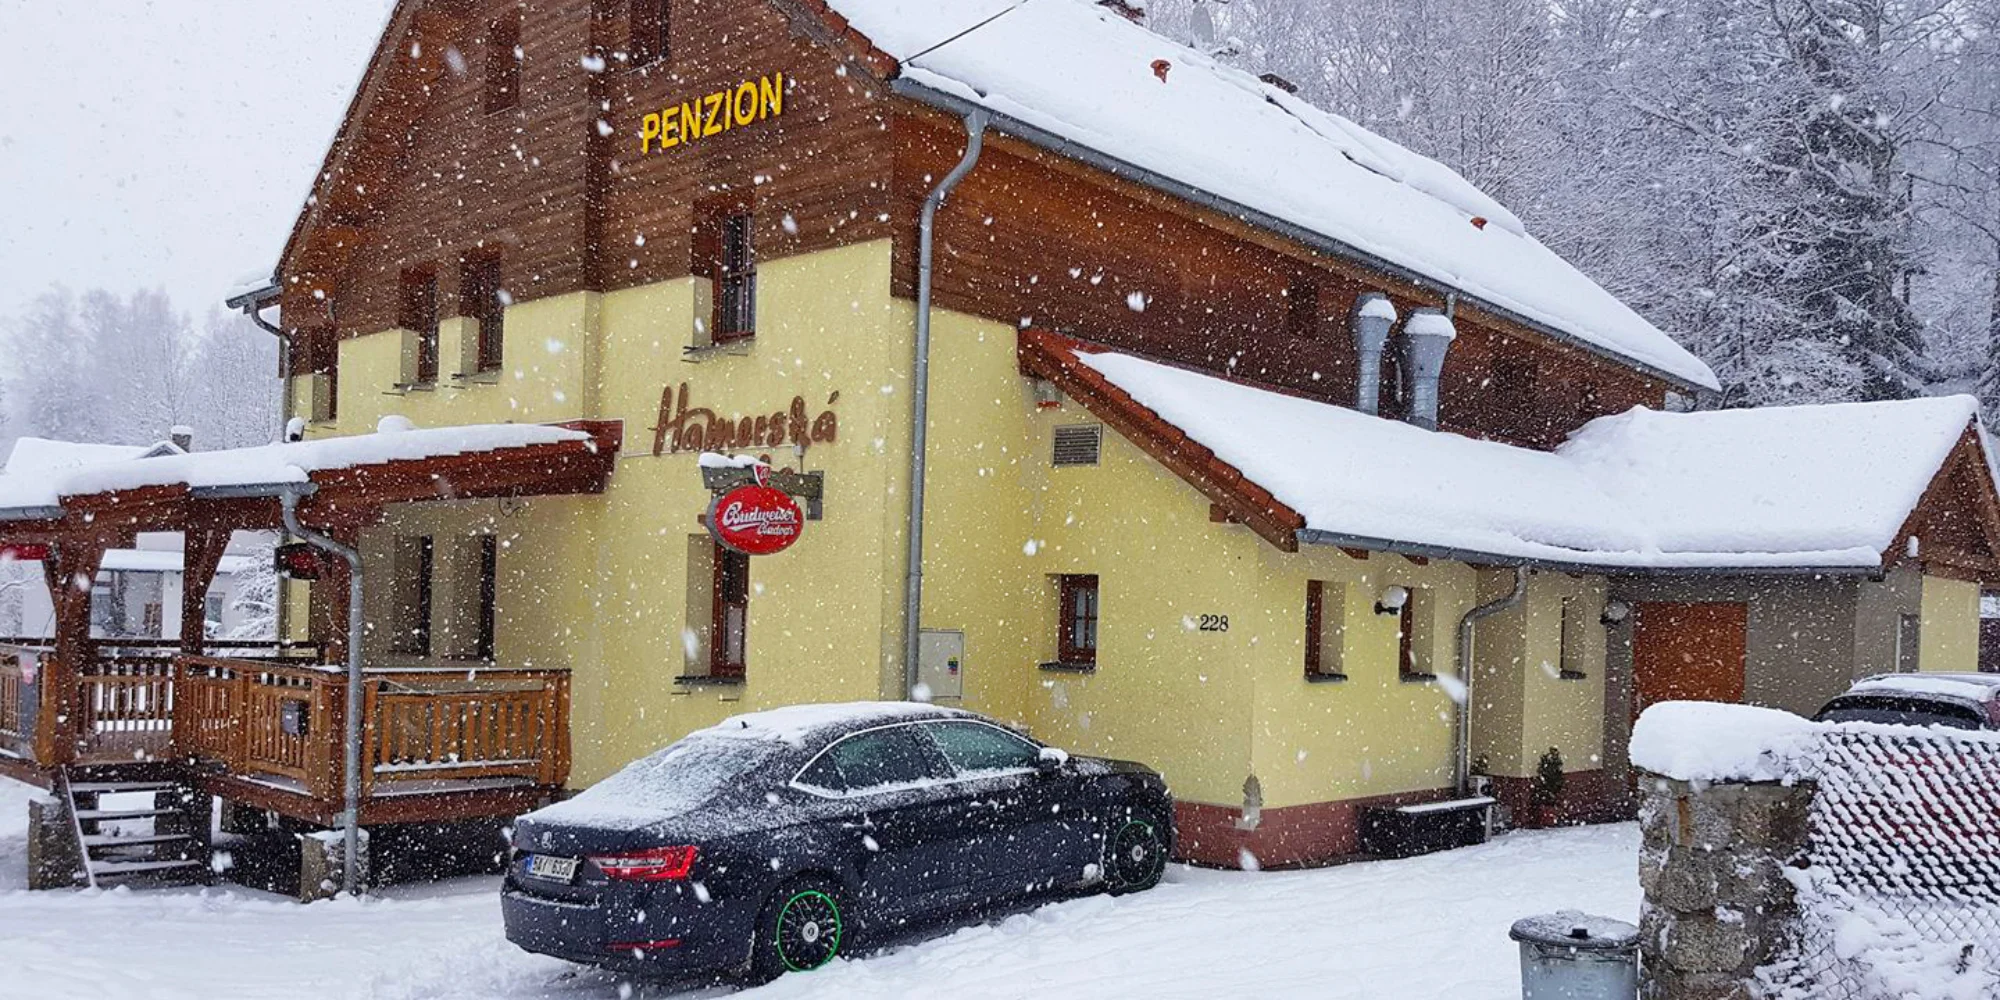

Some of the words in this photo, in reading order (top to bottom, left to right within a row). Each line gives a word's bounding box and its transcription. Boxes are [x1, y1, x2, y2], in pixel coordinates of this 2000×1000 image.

[643, 71, 782, 154] PENZION
[648, 382, 840, 457] Hamerská
[722, 501, 798, 529] Budweiser
[756, 522, 794, 536] Budvar
[1199, 613, 1229, 632] 228
